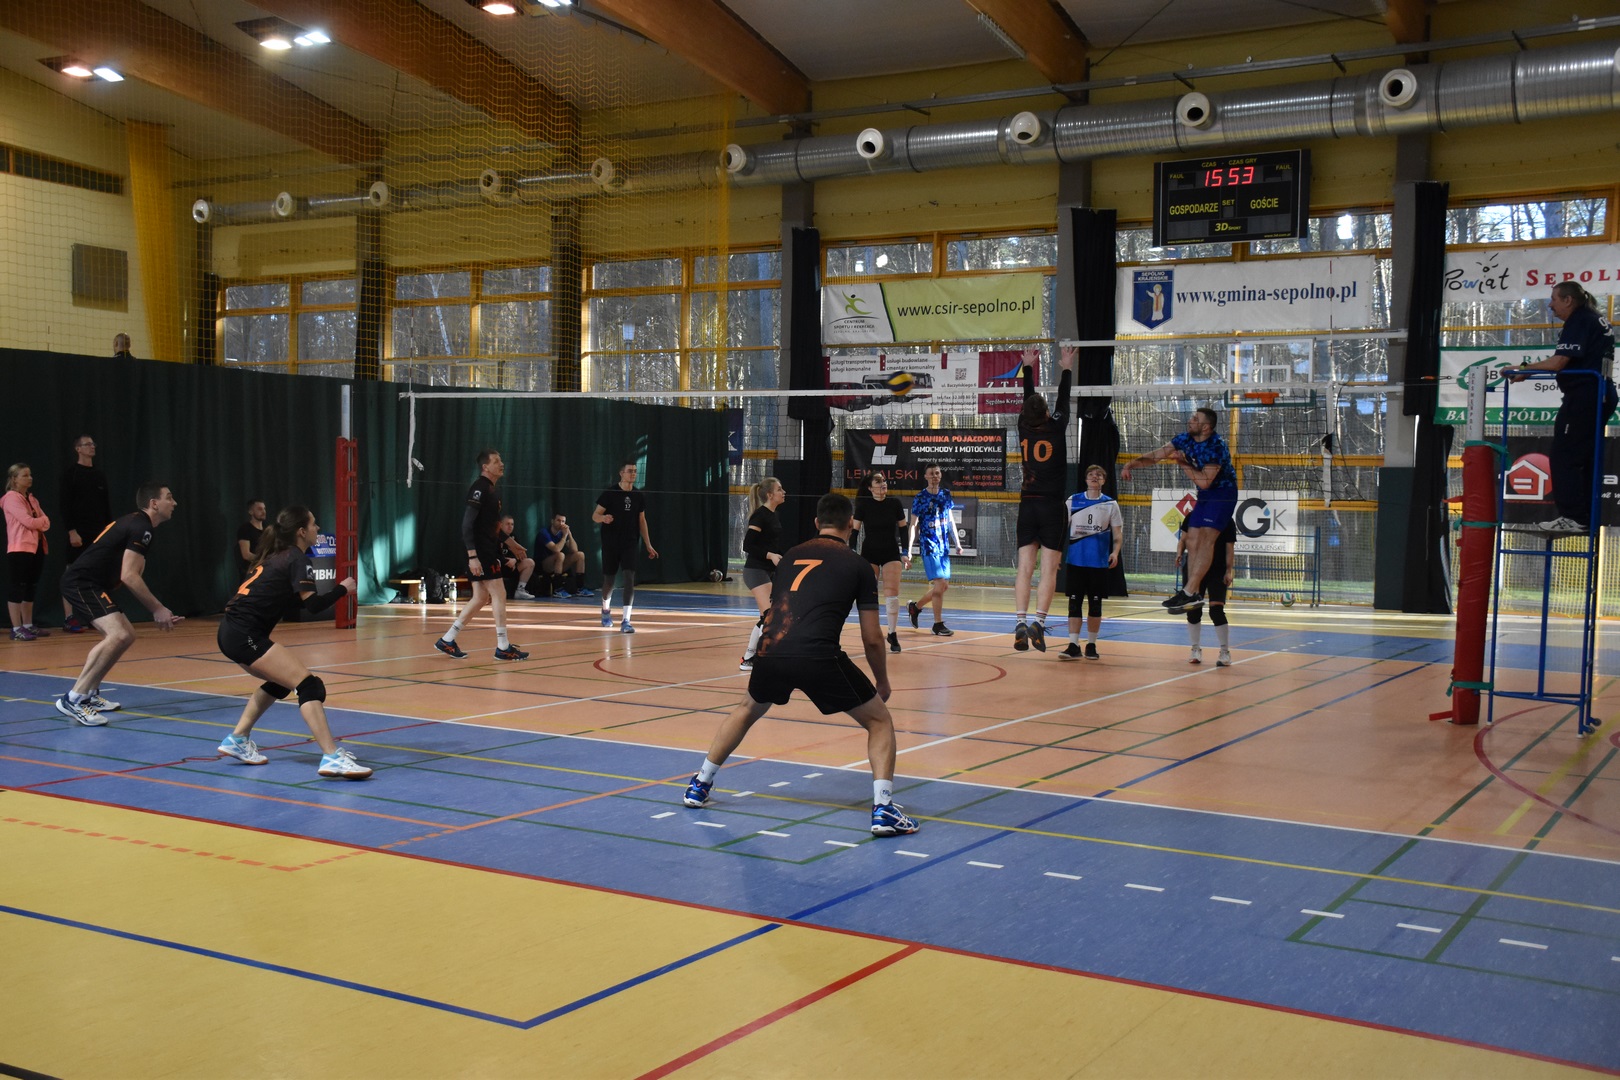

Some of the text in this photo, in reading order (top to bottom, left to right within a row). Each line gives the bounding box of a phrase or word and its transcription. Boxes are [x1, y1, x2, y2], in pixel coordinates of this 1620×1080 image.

[1245, 157, 1258, 165] GRY
[1169, 202, 1219, 216] GOSPODARZE
[1250, 196, 1279, 210] GOŚCIE
[1444, 266, 1509, 294] Powiat
[1176, 281, 1357, 307] www.gmina-sepolno.pl
[897, 296, 1035, 317] www.csir-sepolno.pl
[1445, 410, 1491, 421] BAK
[902, 435, 1002, 443] MECHANIKA POJAZDOWA
[1020, 438, 1053, 463] 10
[1087, 513, 1093, 525] 8
[1251, 543, 1287, 552] KRAJEŃSKIE
[237, 564, 264, 596] 2
[790, 559, 824, 592] 7
